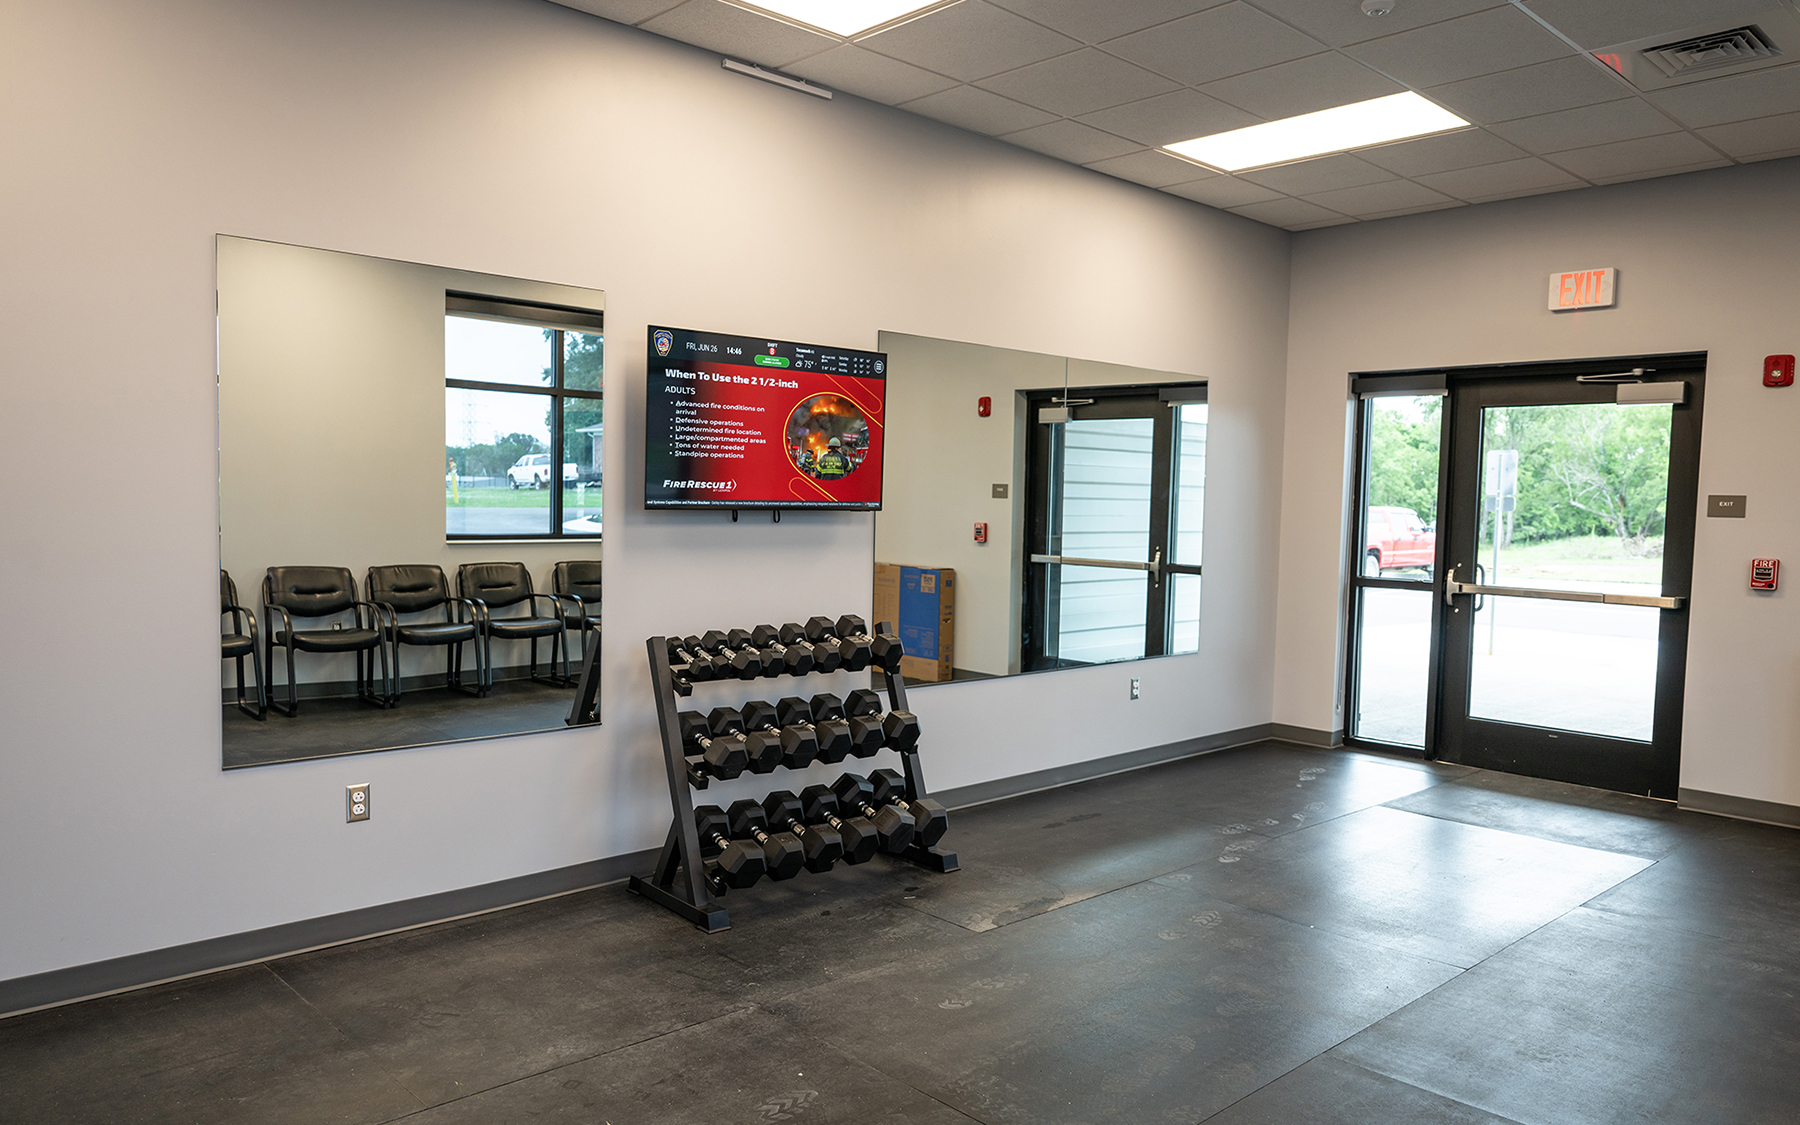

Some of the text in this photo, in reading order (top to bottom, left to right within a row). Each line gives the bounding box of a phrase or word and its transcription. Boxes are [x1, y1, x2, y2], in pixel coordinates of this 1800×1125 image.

[1559, 270, 1605, 306] EXIT
[686, 342, 697, 351] FRI,
[698, 344, 710, 352] JUN
[727, 347, 742, 355] 14:46
[665, 369, 696, 379] When
[698, 372, 710, 380] To
[712, 373, 731, 382] Use
[733, 376, 749, 384] the
[759, 378, 798, 388] 1/2-inch
[665, 386, 696, 395] ADULTS
[675, 426, 723, 434] Undetermined
[675, 434, 748, 443] Large/compartmented
